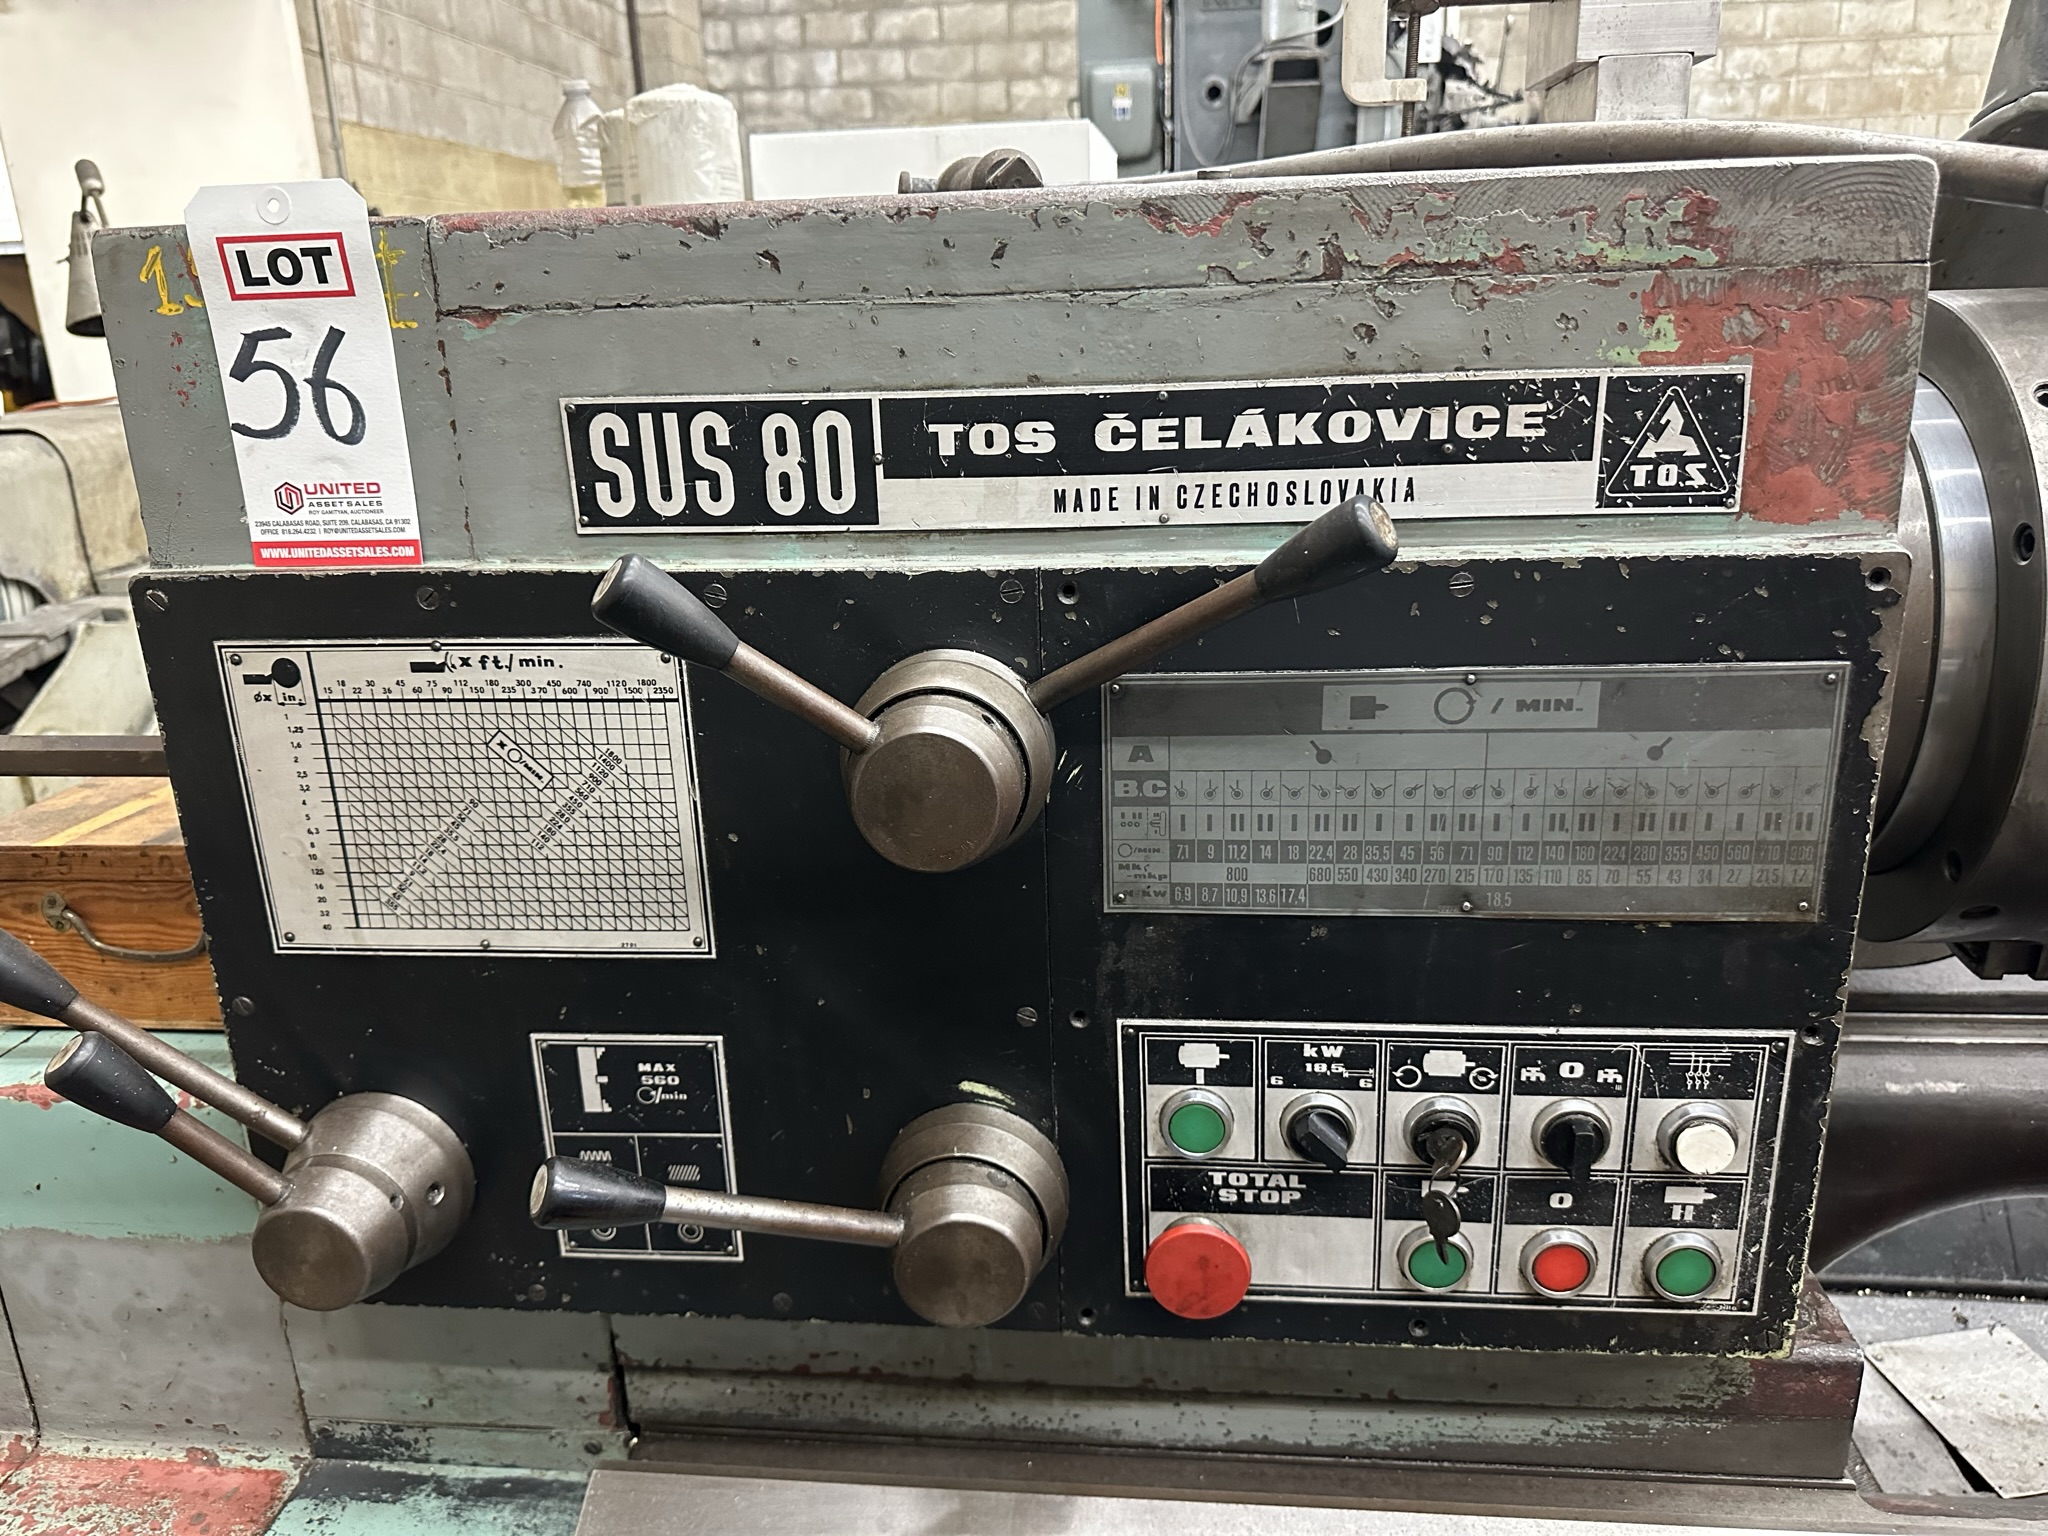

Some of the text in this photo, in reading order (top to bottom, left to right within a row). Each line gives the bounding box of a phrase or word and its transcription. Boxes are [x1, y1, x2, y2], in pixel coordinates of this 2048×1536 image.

[235, 247, 333, 287] LOT
[229, 325, 367, 446] 56
[589, 401, 1550, 518] SUS 80 TOS ČELÁKOVICE
[303, 482, 381, 495] UNITED
[1053, 476, 1415, 513] MADE IN CZECHOSLOVAKIA
[308, 500, 343, 508] ASSET
[260, 546, 415, 559] WWW.UNITEDASSETSALES.COM
[336, 678, 656, 687] 18 30 45 75 112 180 300 450 740 1120 1800
[323, 686, 673, 694] 15 22 36 60 90 150 235 370 600 900 1500 2350
[1516, 698, 1583, 712] MIN.
[287, 726, 304, 734] 1,25
[290, 741, 302, 749] 1,6
[605, 747, 623, 765] 1800
[1127, 745, 1154, 763] A
[598, 754, 616, 771] 1400
[296, 771, 308, 779] 2,5
[591, 762, 609, 779] 1120
[588, 772, 602, 786] 900
[299, 784, 311, 793] 3,2
[581, 780, 596, 794] 710
[574, 787, 589, 801] 560
[469, 798, 479, 809] 90
[568, 795, 583, 808] 450
[462, 805, 472, 815] 71
[562, 802, 576, 815] 355
[457, 813, 466, 823] 56
[549, 816, 563, 829] 224
[555, 809, 571, 823] 280
[451, 820, 461, 830] 45
[543, 824, 557, 836] 180
[437, 834, 448, 844] 28
[537, 831, 550, 843] 140
[531, 838, 545, 850] 112
[308, 853, 318, 861] 10
[425, 847, 434, 857] 18
[1207, 844, 1215, 859] 9
[1227, 844, 1247, 861] 11,2
[1260, 844, 1272, 859] 14
[1287, 844, 1300, 860] 18
[1343, 845, 1358, 860] 28
[1400, 845, 1415, 861] 45
[1430, 845, 1444, 861] 56
[1460, 846, 1473, 861] 71
[1487, 845, 1503, 861] 90
[1517, 845, 1534, 861] 112
[1545, 845, 1565, 860] 140
[1575, 845, 1595, 861] 180
[1604, 845, 1626, 861] 224
[1633, 845, 1656, 861] 280
[1665, 846, 1688, 861] 355
[1696, 845, 1719, 860] 450
[1726, 845, 1749, 860] 560
[419, 855, 428, 863] 14
[1226, 867, 1248, 881] 800
[1309, 867, 1331, 882] 680
[1337, 867, 1358, 882] 550
[1366, 867, 1388, 883] 430
[1395, 867, 1417, 883] 340
[1424, 868, 1446, 883] 270
[1455, 868, 1475, 883] 215
[1483, 868, 1504, 883] 170
[1514, 868, 1533, 883] 135
[1544, 869, 1562, 884] 110
[1576, 869, 1592, 884] 85
[1605, 869, 1620, 884] 70
[1636, 869, 1651, 884] 55
[1666, 869, 1681, 884] 43
[1697, 869, 1713, 884] 34
[1726, 868, 1743, 884] 27
[1302, 1043, 1343, 1057] kW
[637, 1062, 676, 1072] MAX
[640, 1074, 680, 1086] 560
[1270, 1075, 1373, 1088] 6 6
[1207, 1171, 1306, 1188] TOTAL
[1218, 1189, 1301, 1204] STOP
